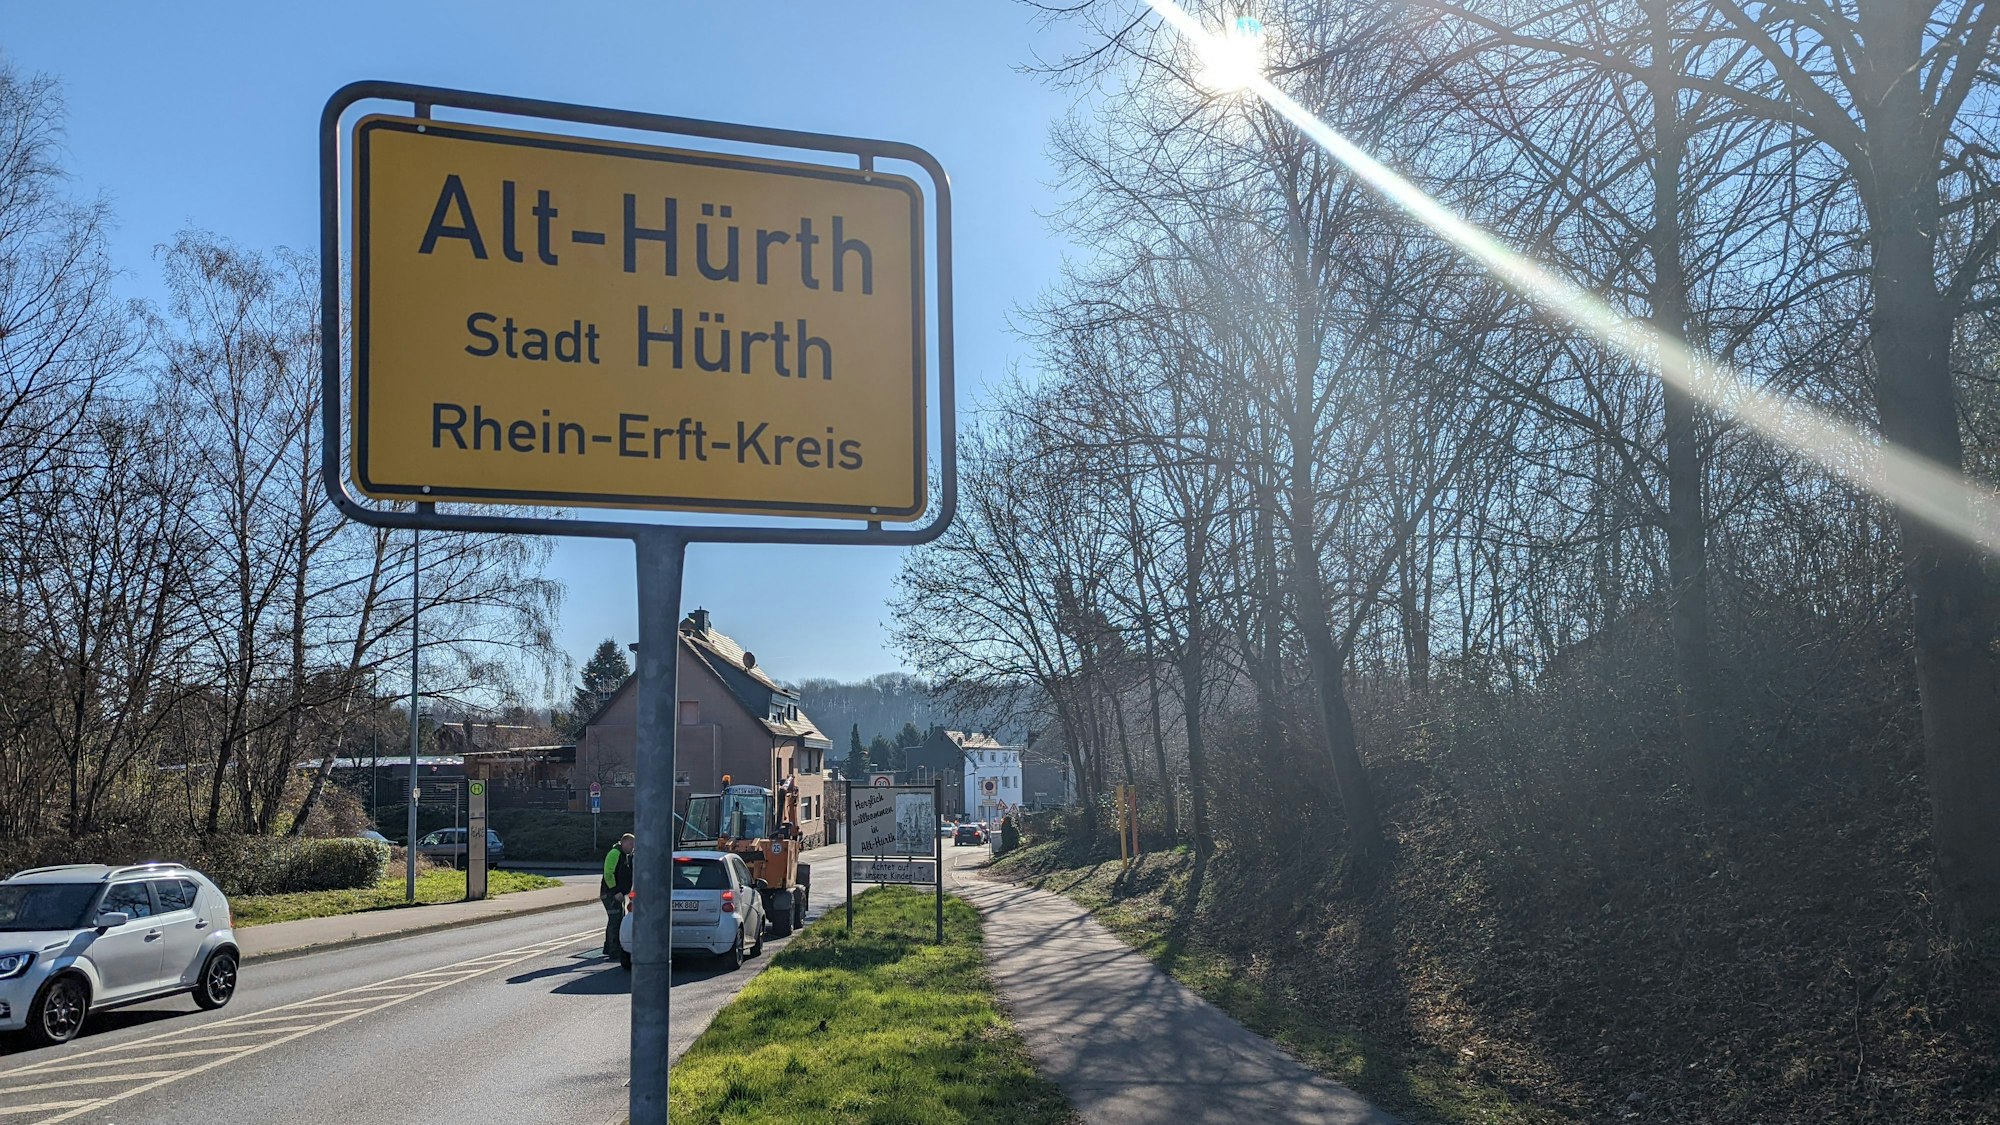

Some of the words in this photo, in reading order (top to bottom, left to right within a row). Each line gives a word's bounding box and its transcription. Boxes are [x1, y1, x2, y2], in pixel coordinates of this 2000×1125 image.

[417, 173, 875, 295] Alt-Hürth
[463, 311, 601, 365] Stadt
[637, 304, 833, 381] Hürth
[431, 402, 864, 471] Rhein-Erft-Kreis
[854, 792, 884, 811] Herzlich
[852, 806, 894, 827] willkommen
[870, 825, 879, 834] in
[773, 844, 781, 853] 25
[865, 872, 888, 880] unsere
[890, 871, 916, 880] Kinder!
[871, 863, 895, 871] Achtet
[897, 863, 910, 871] auf
